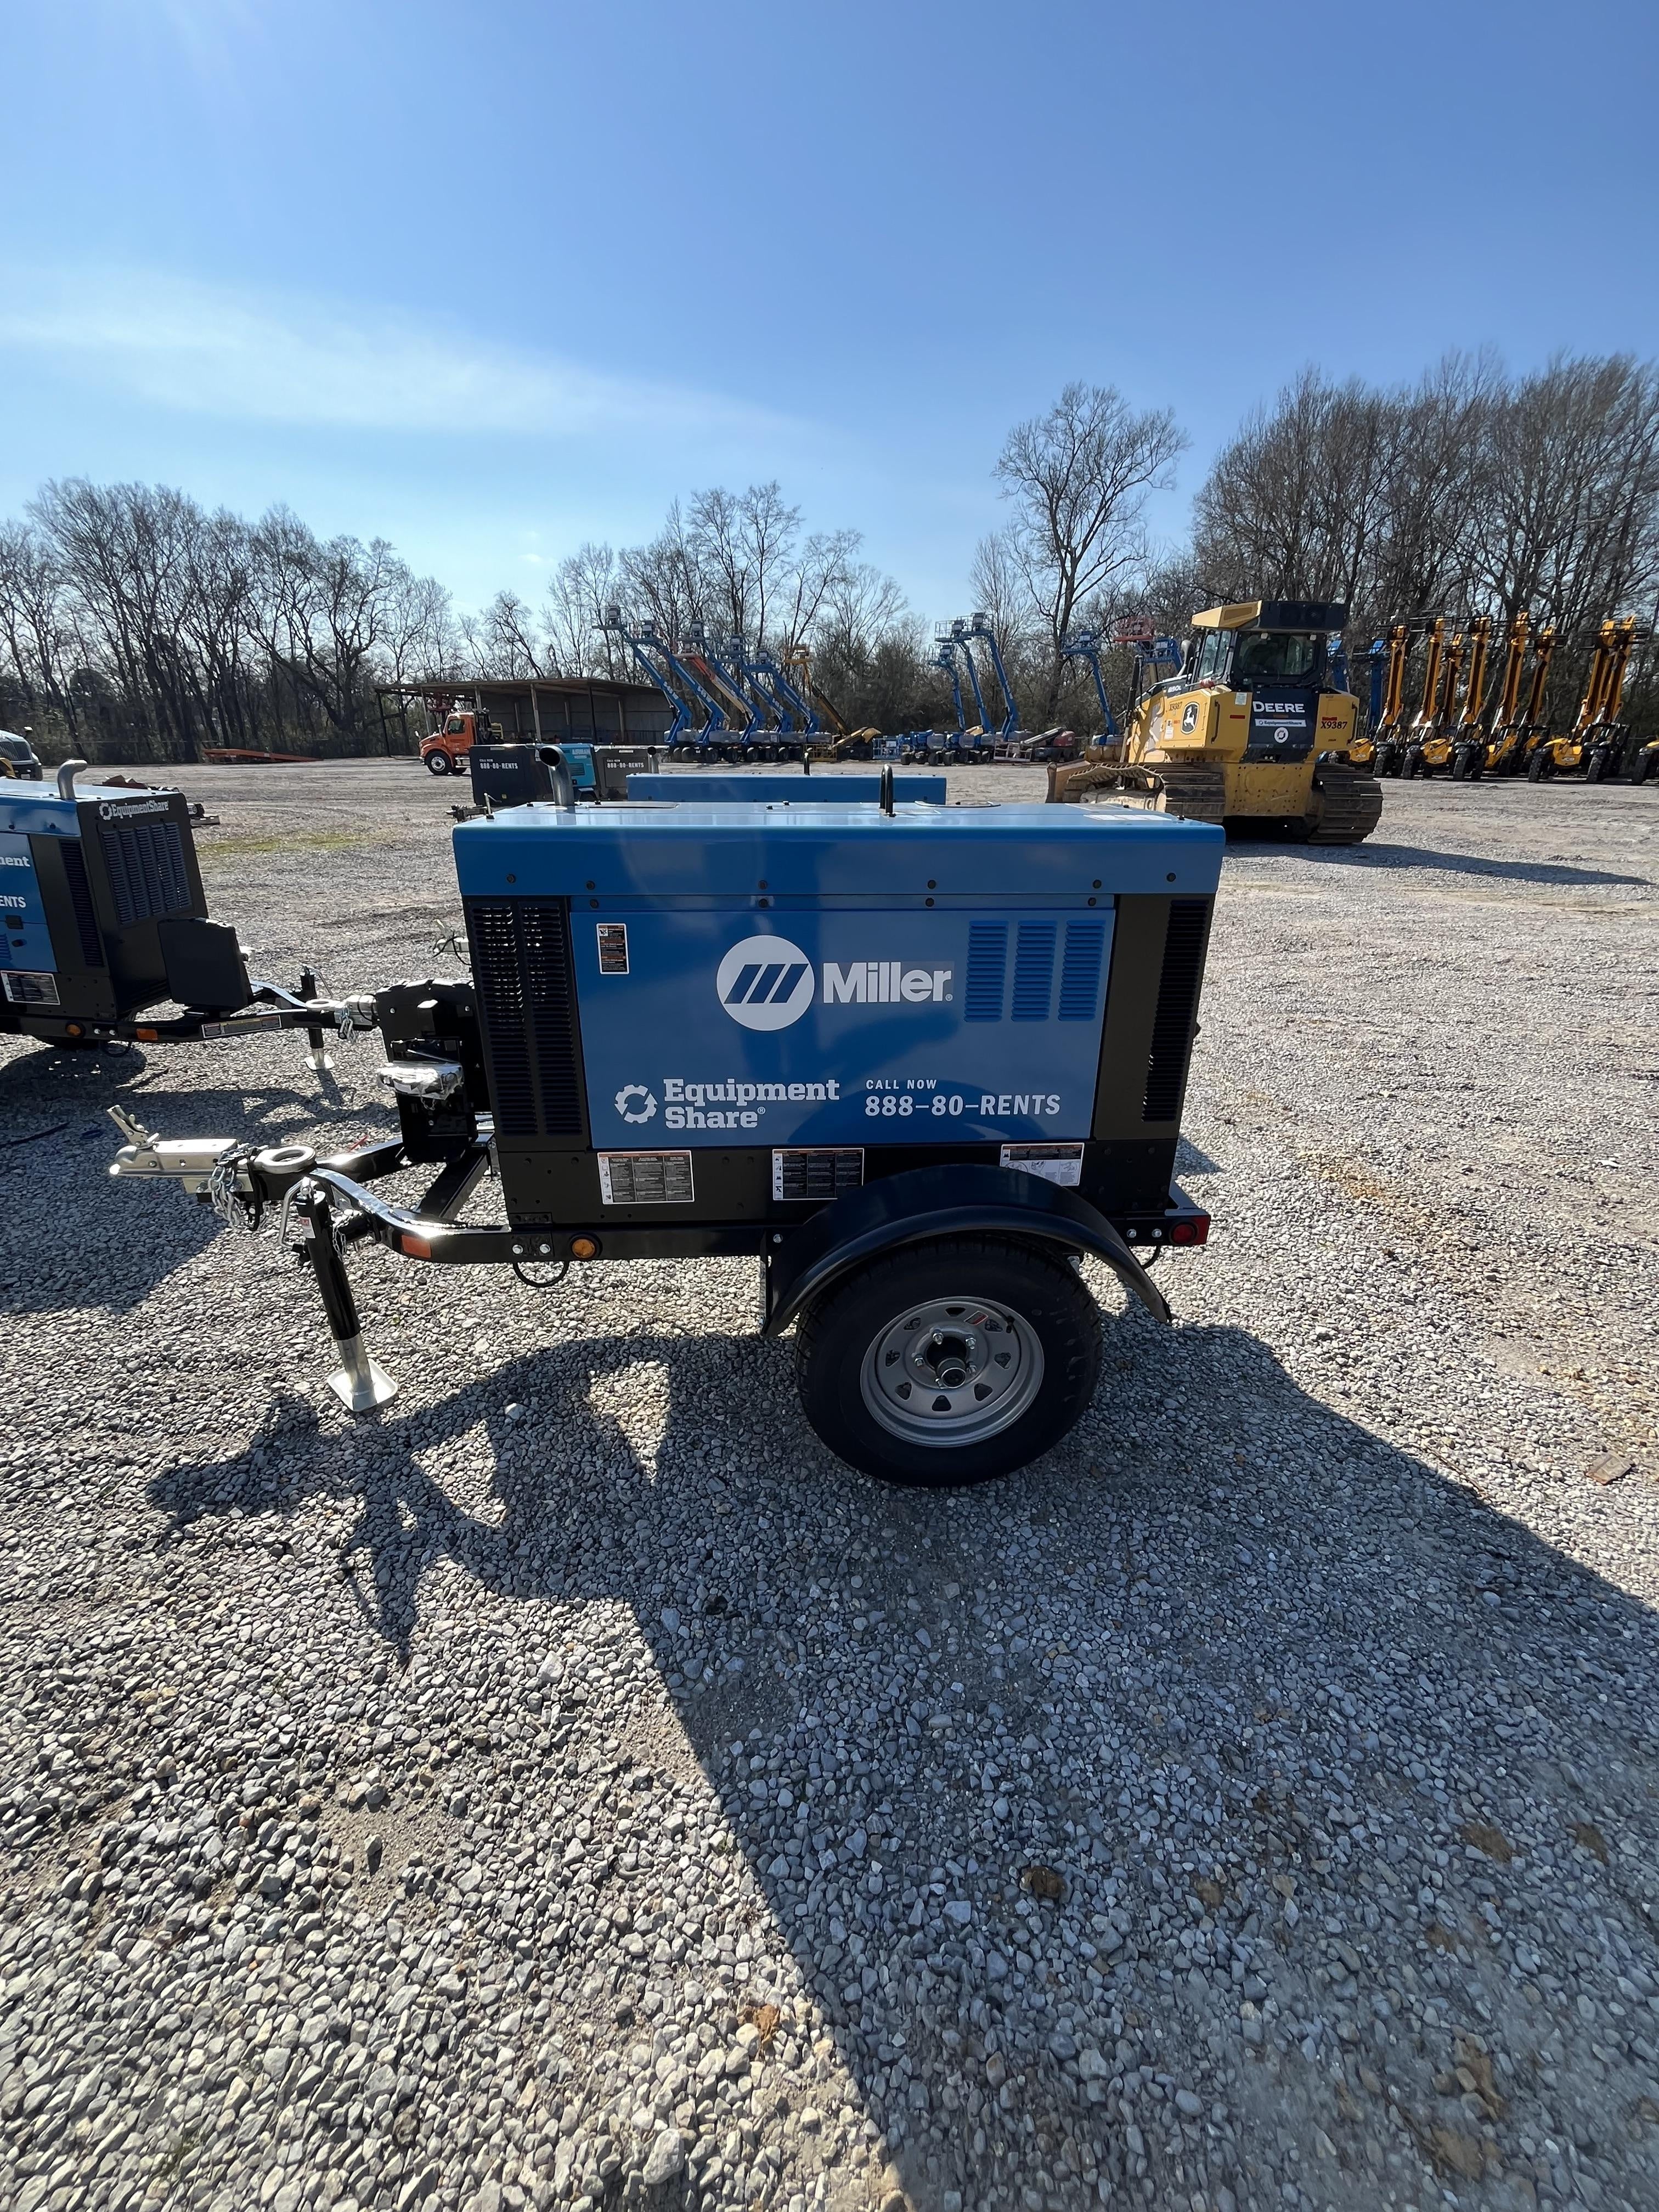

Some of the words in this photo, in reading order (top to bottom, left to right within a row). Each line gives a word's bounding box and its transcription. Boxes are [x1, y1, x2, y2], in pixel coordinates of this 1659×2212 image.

[1252, 701, 1305, 713] DEERE
[1321, 721, 1348, 730] X9387
[866, 1079, 899, 1090] CALL
[907, 1079, 937, 1090] NOW
[663, 1078, 840, 1106] Equipment
[865, 1094, 1060, 1116] 888-80-RENTS
